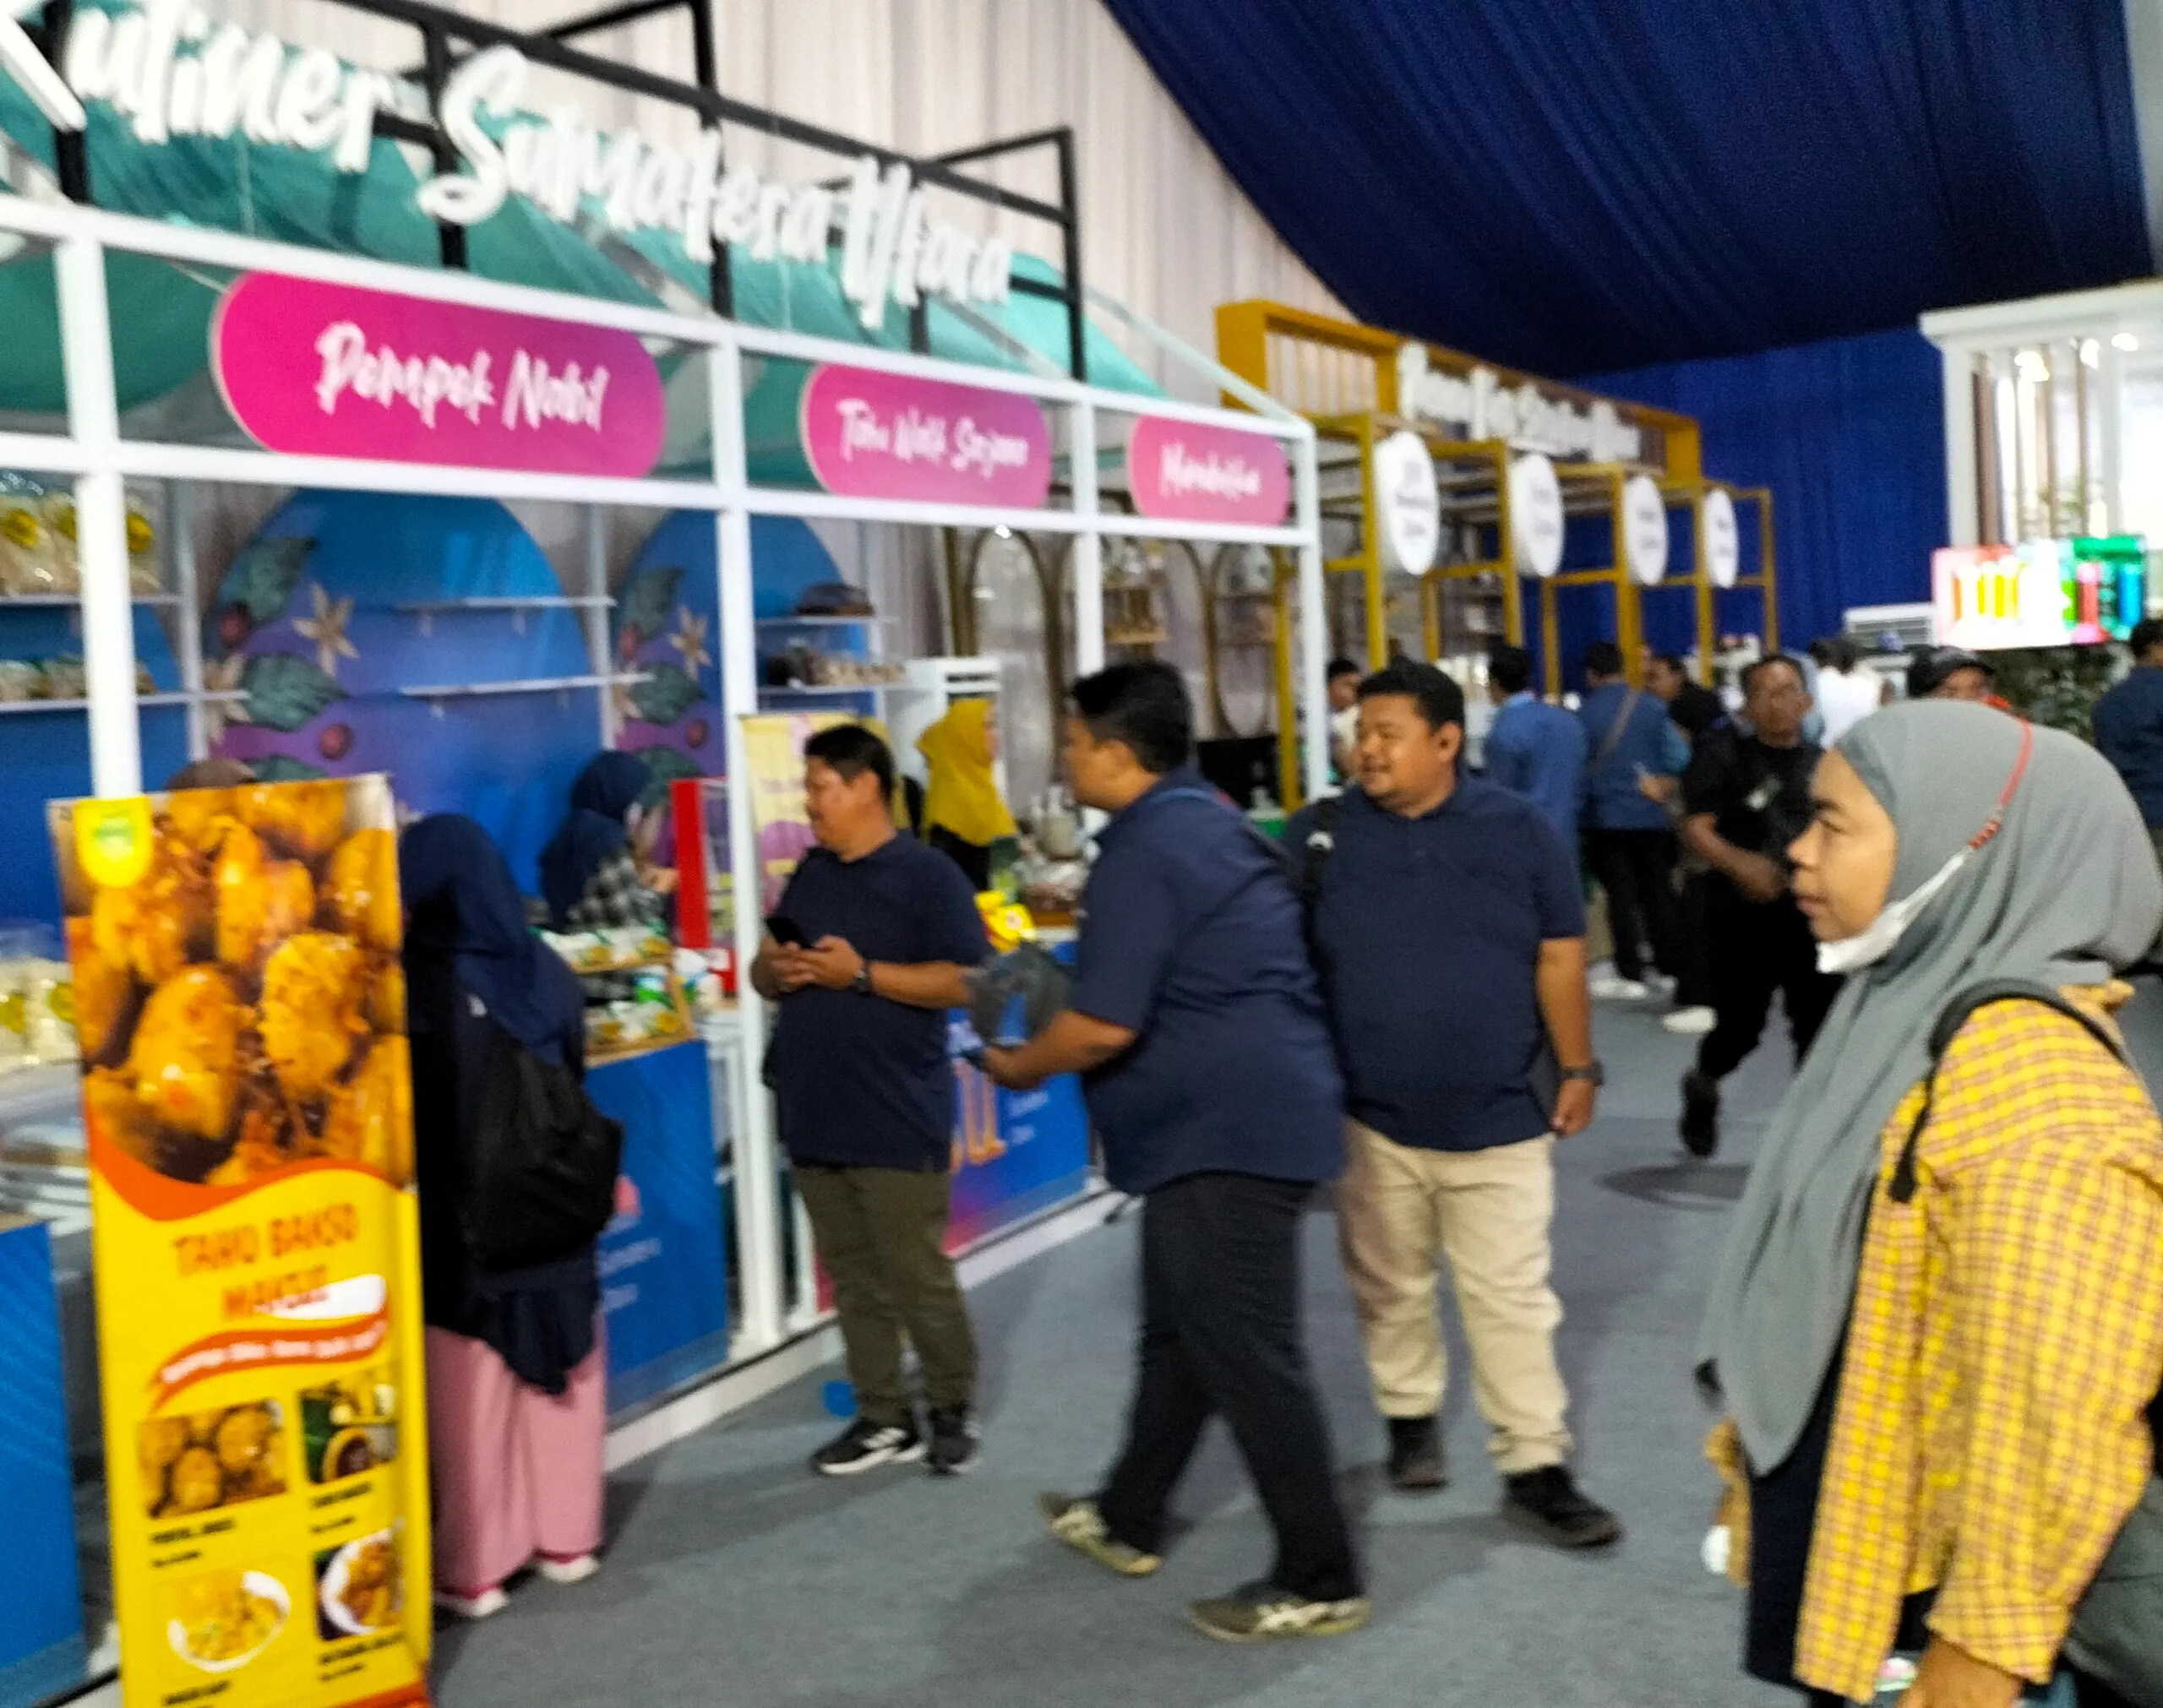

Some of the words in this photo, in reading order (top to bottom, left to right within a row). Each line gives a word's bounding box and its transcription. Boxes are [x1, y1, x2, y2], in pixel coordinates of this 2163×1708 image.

[314, 319, 496, 428] Pempek
[173, 1224, 257, 1278] TAHU
[270, 1202, 357, 1258] BAKSO
